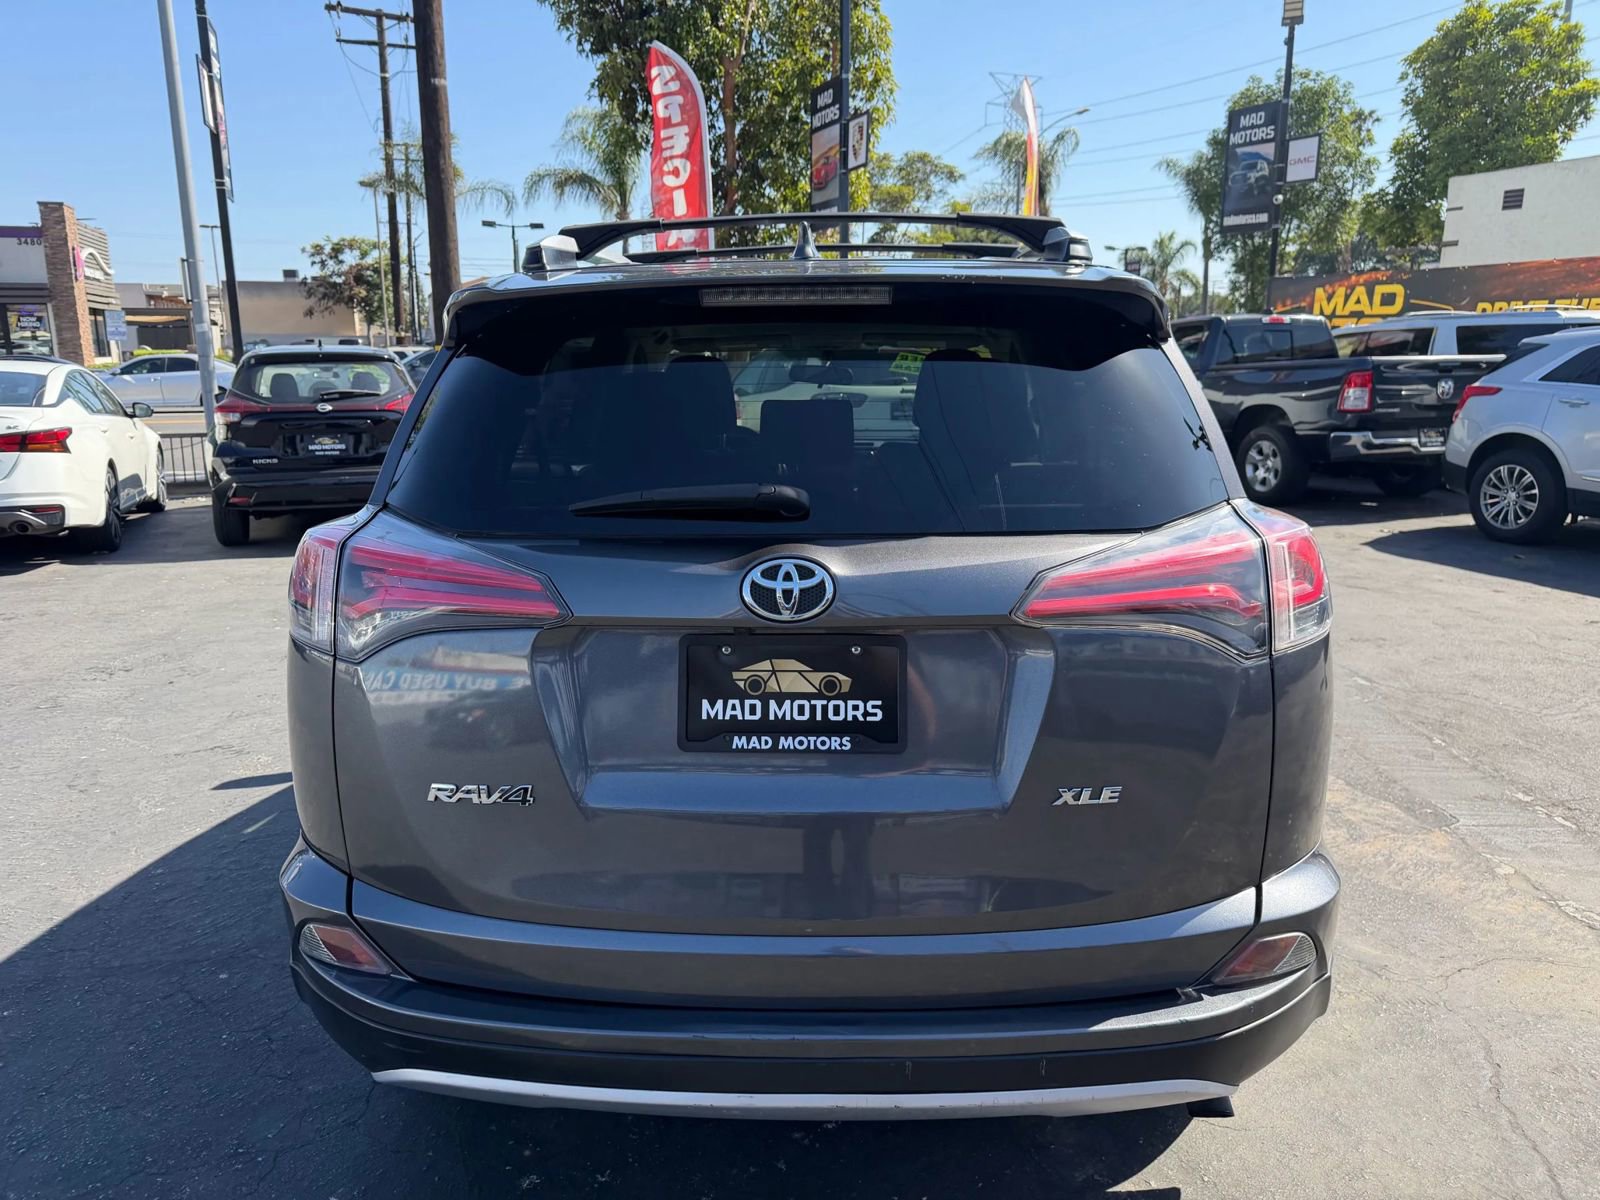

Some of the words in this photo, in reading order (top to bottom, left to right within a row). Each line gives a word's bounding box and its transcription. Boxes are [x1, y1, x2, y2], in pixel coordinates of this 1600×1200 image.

[817, 88, 833, 109] MAD
[812, 104, 840, 129] MOTORS
[1239, 111, 1265, 129] MAD
[1229, 125, 1276, 146] MOTORS
[1288, 156, 1315, 166] GMC
[16, 238, 42, 246] 3480
[1313, 283, 1405, 316] MAD
[702, 699, 762, 720] MAD
[769, 700, 883, 721] MOTORS
[732, 735, 773, 750] MAD
[778, 736, 851, 750] MOTORS
[427, 783, 533, 806] RAV4
[1052, 786, 1123, 805] XLE
